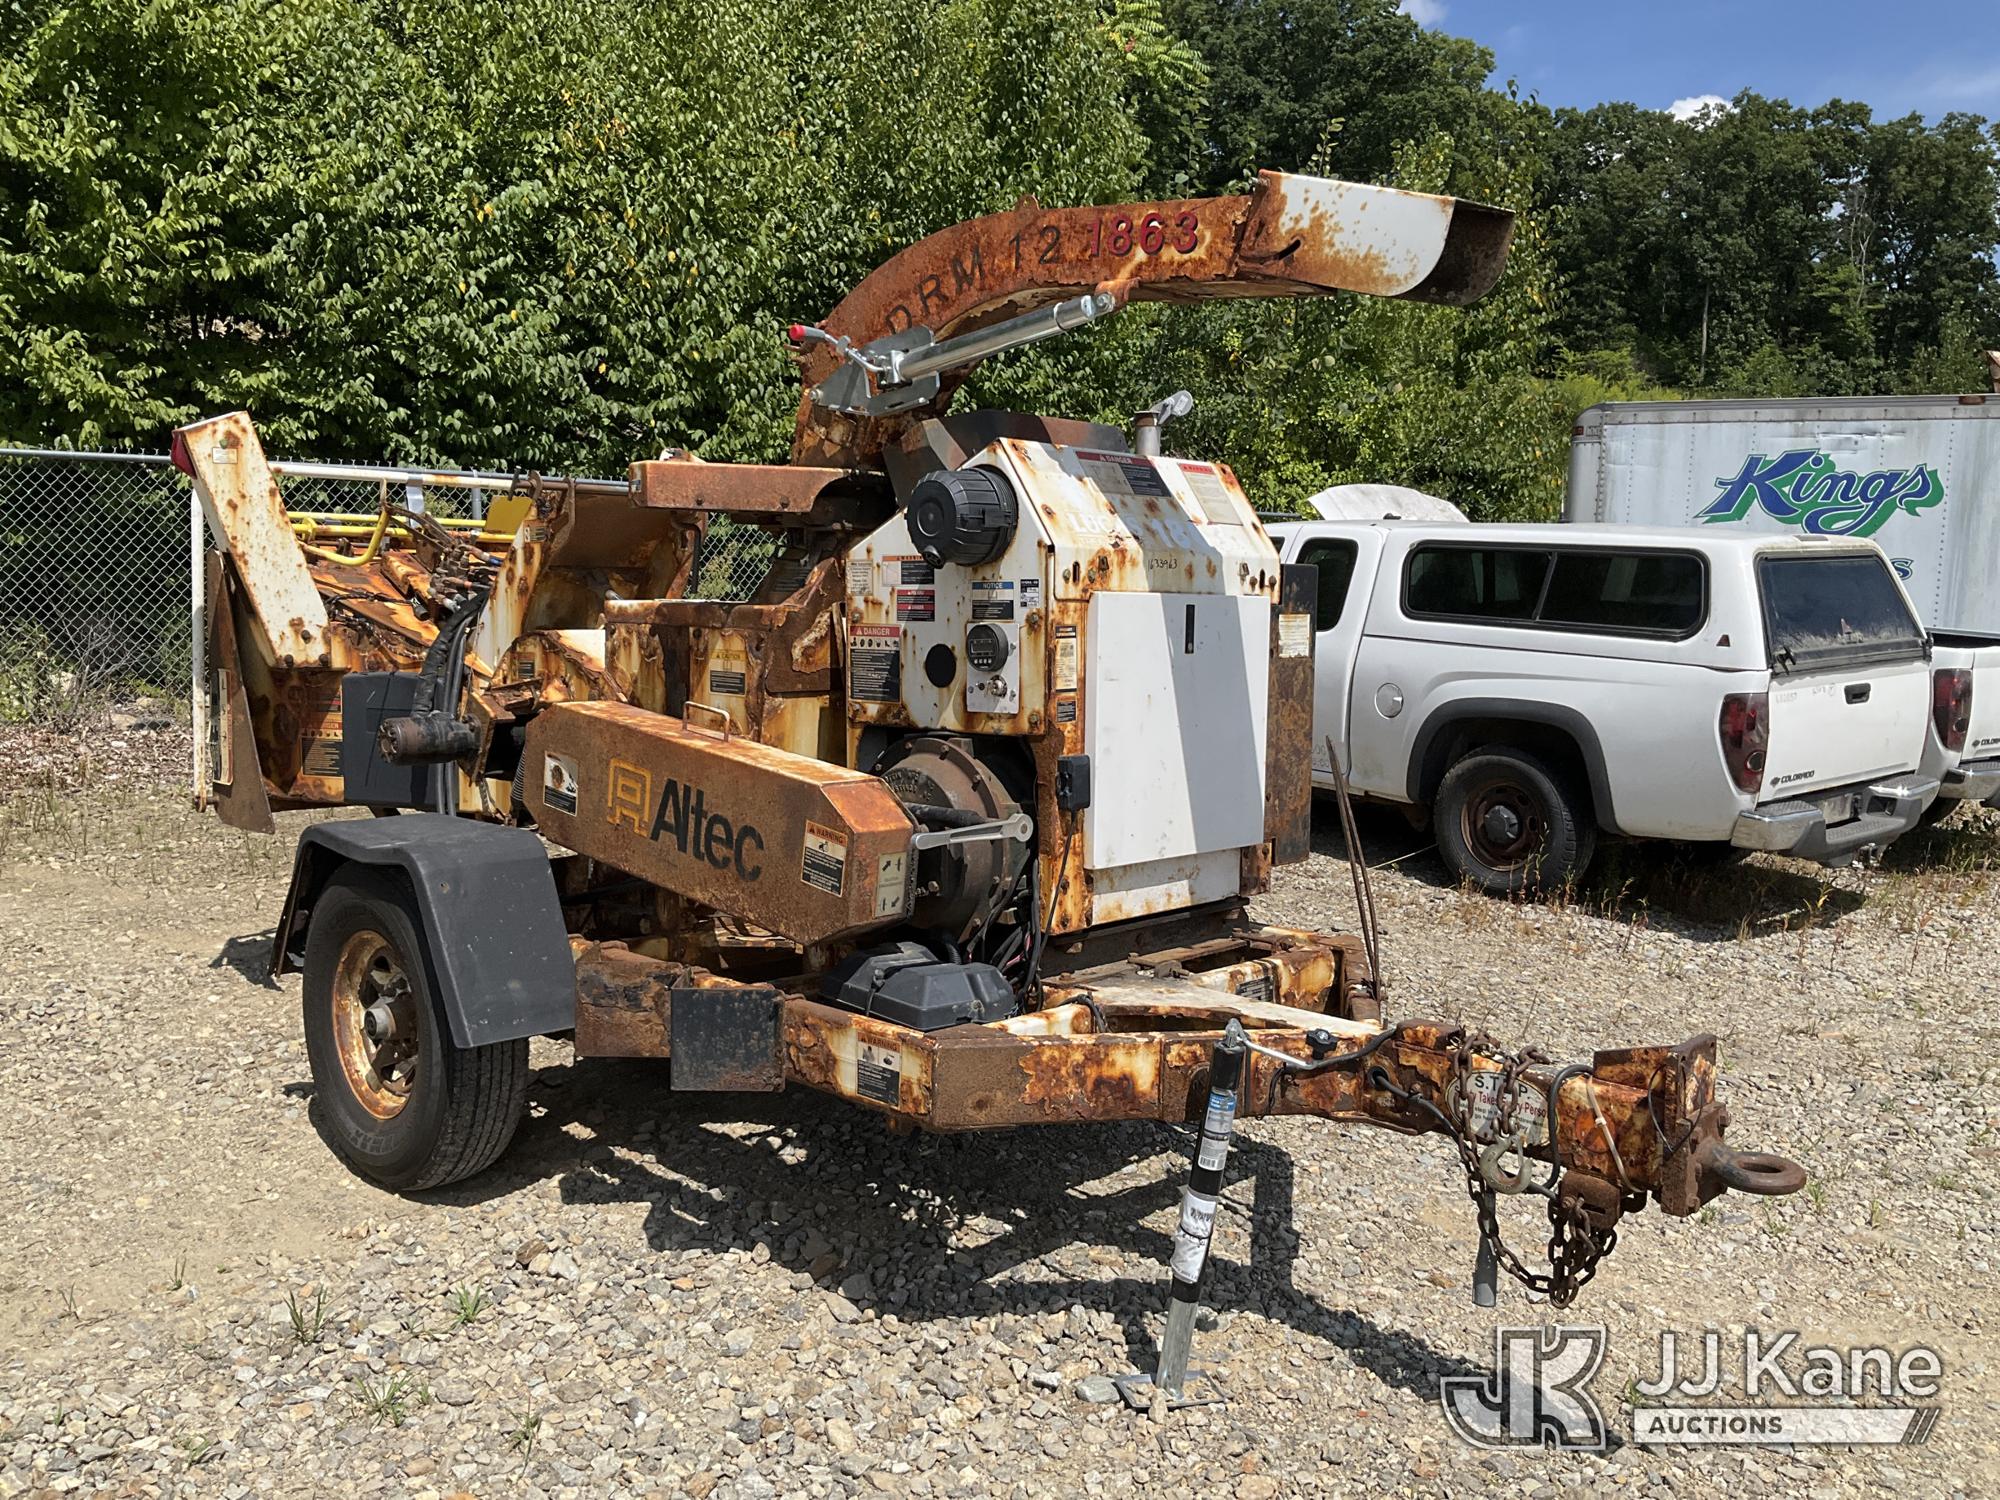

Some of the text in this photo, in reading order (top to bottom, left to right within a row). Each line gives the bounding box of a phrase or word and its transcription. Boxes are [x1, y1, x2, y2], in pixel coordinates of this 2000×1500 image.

[1087, 211, 1198, 257] 1863
[1693, 448, 1943, 537] Kings
[863, 627, 890, 636] DANGER
[1781, 770, 1815, 784] COLORADO
[650, 778, 764, 881] Altec
[1525, 1102, 1547, 1118] Perso
